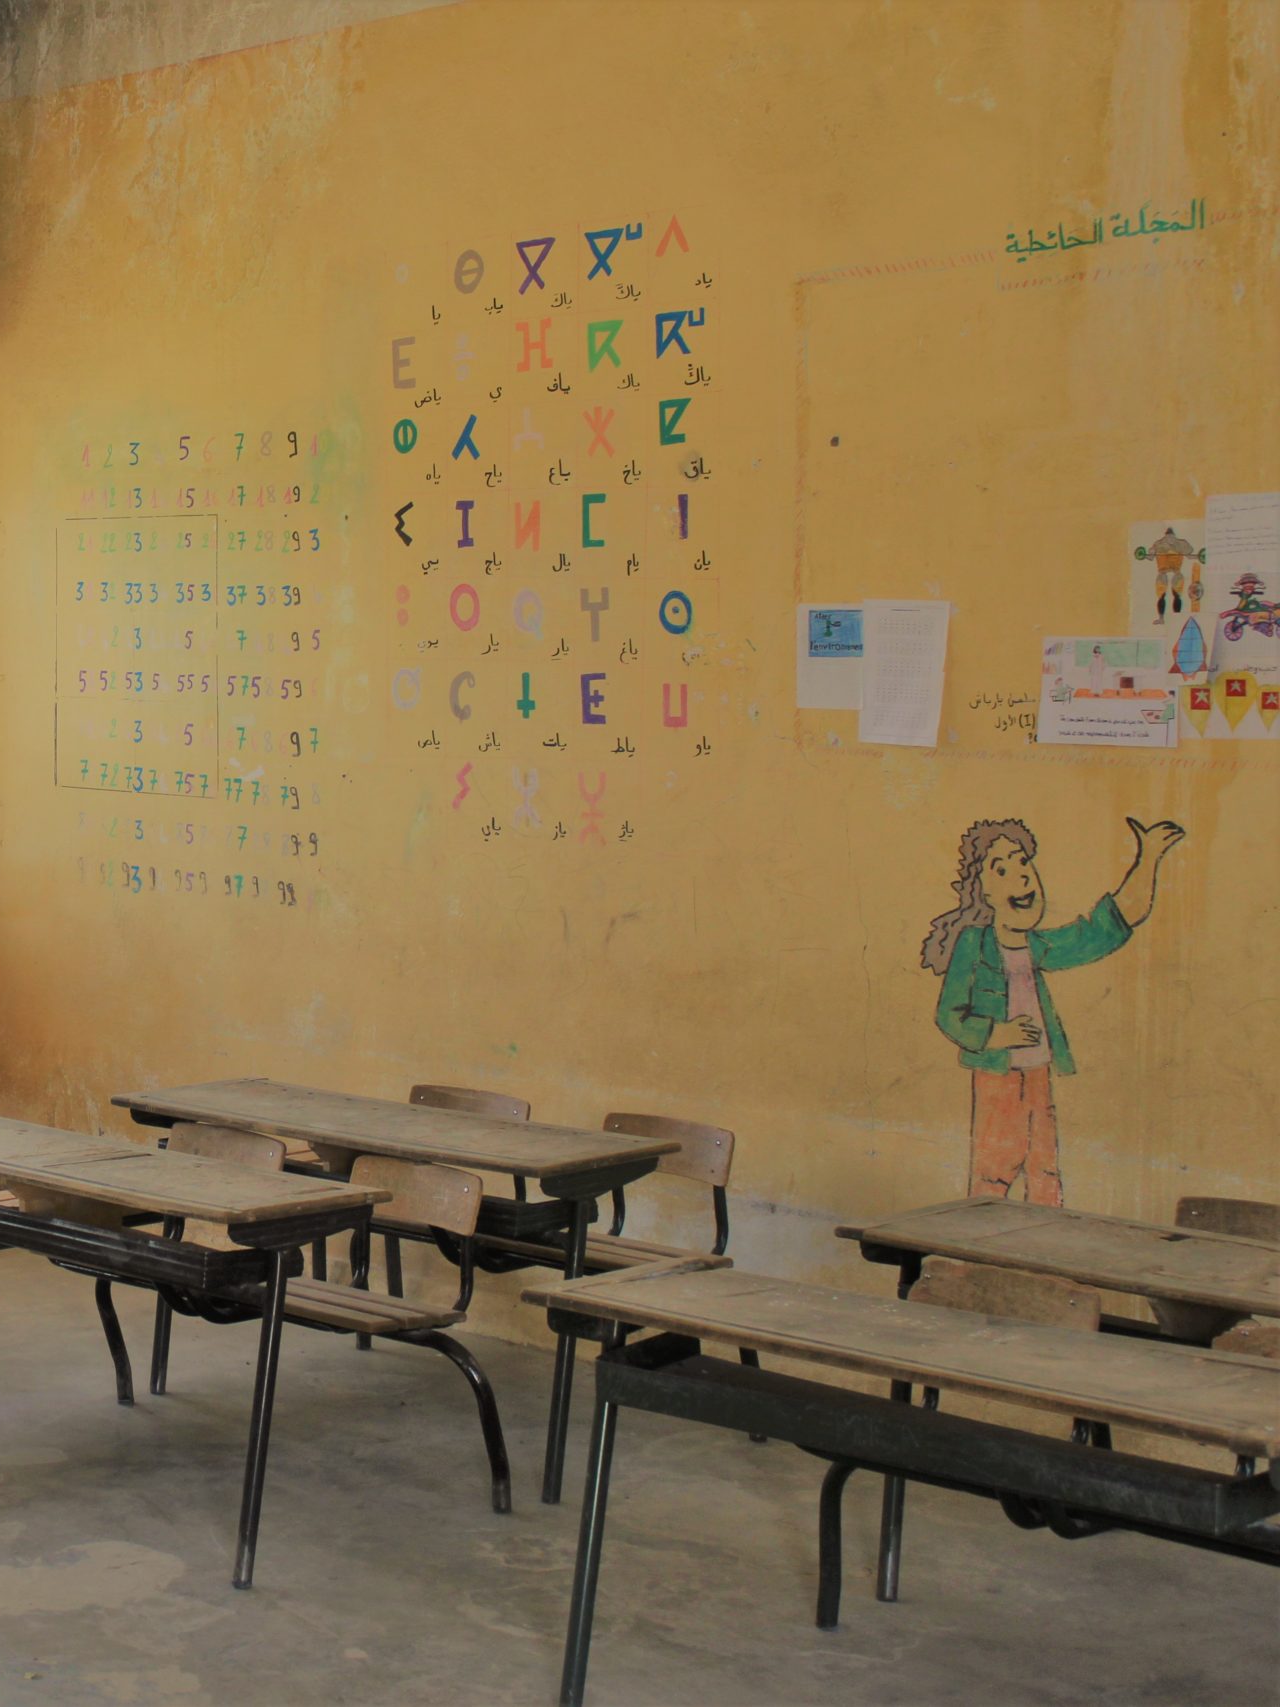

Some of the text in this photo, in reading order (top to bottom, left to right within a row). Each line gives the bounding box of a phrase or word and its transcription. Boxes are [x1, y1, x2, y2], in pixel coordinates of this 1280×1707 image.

[129, 442, 141, 466] 3
[179, 436, 191, 460] 5
[234, 432, 245, 461] 7
[287, 431, 298, 458] 9
